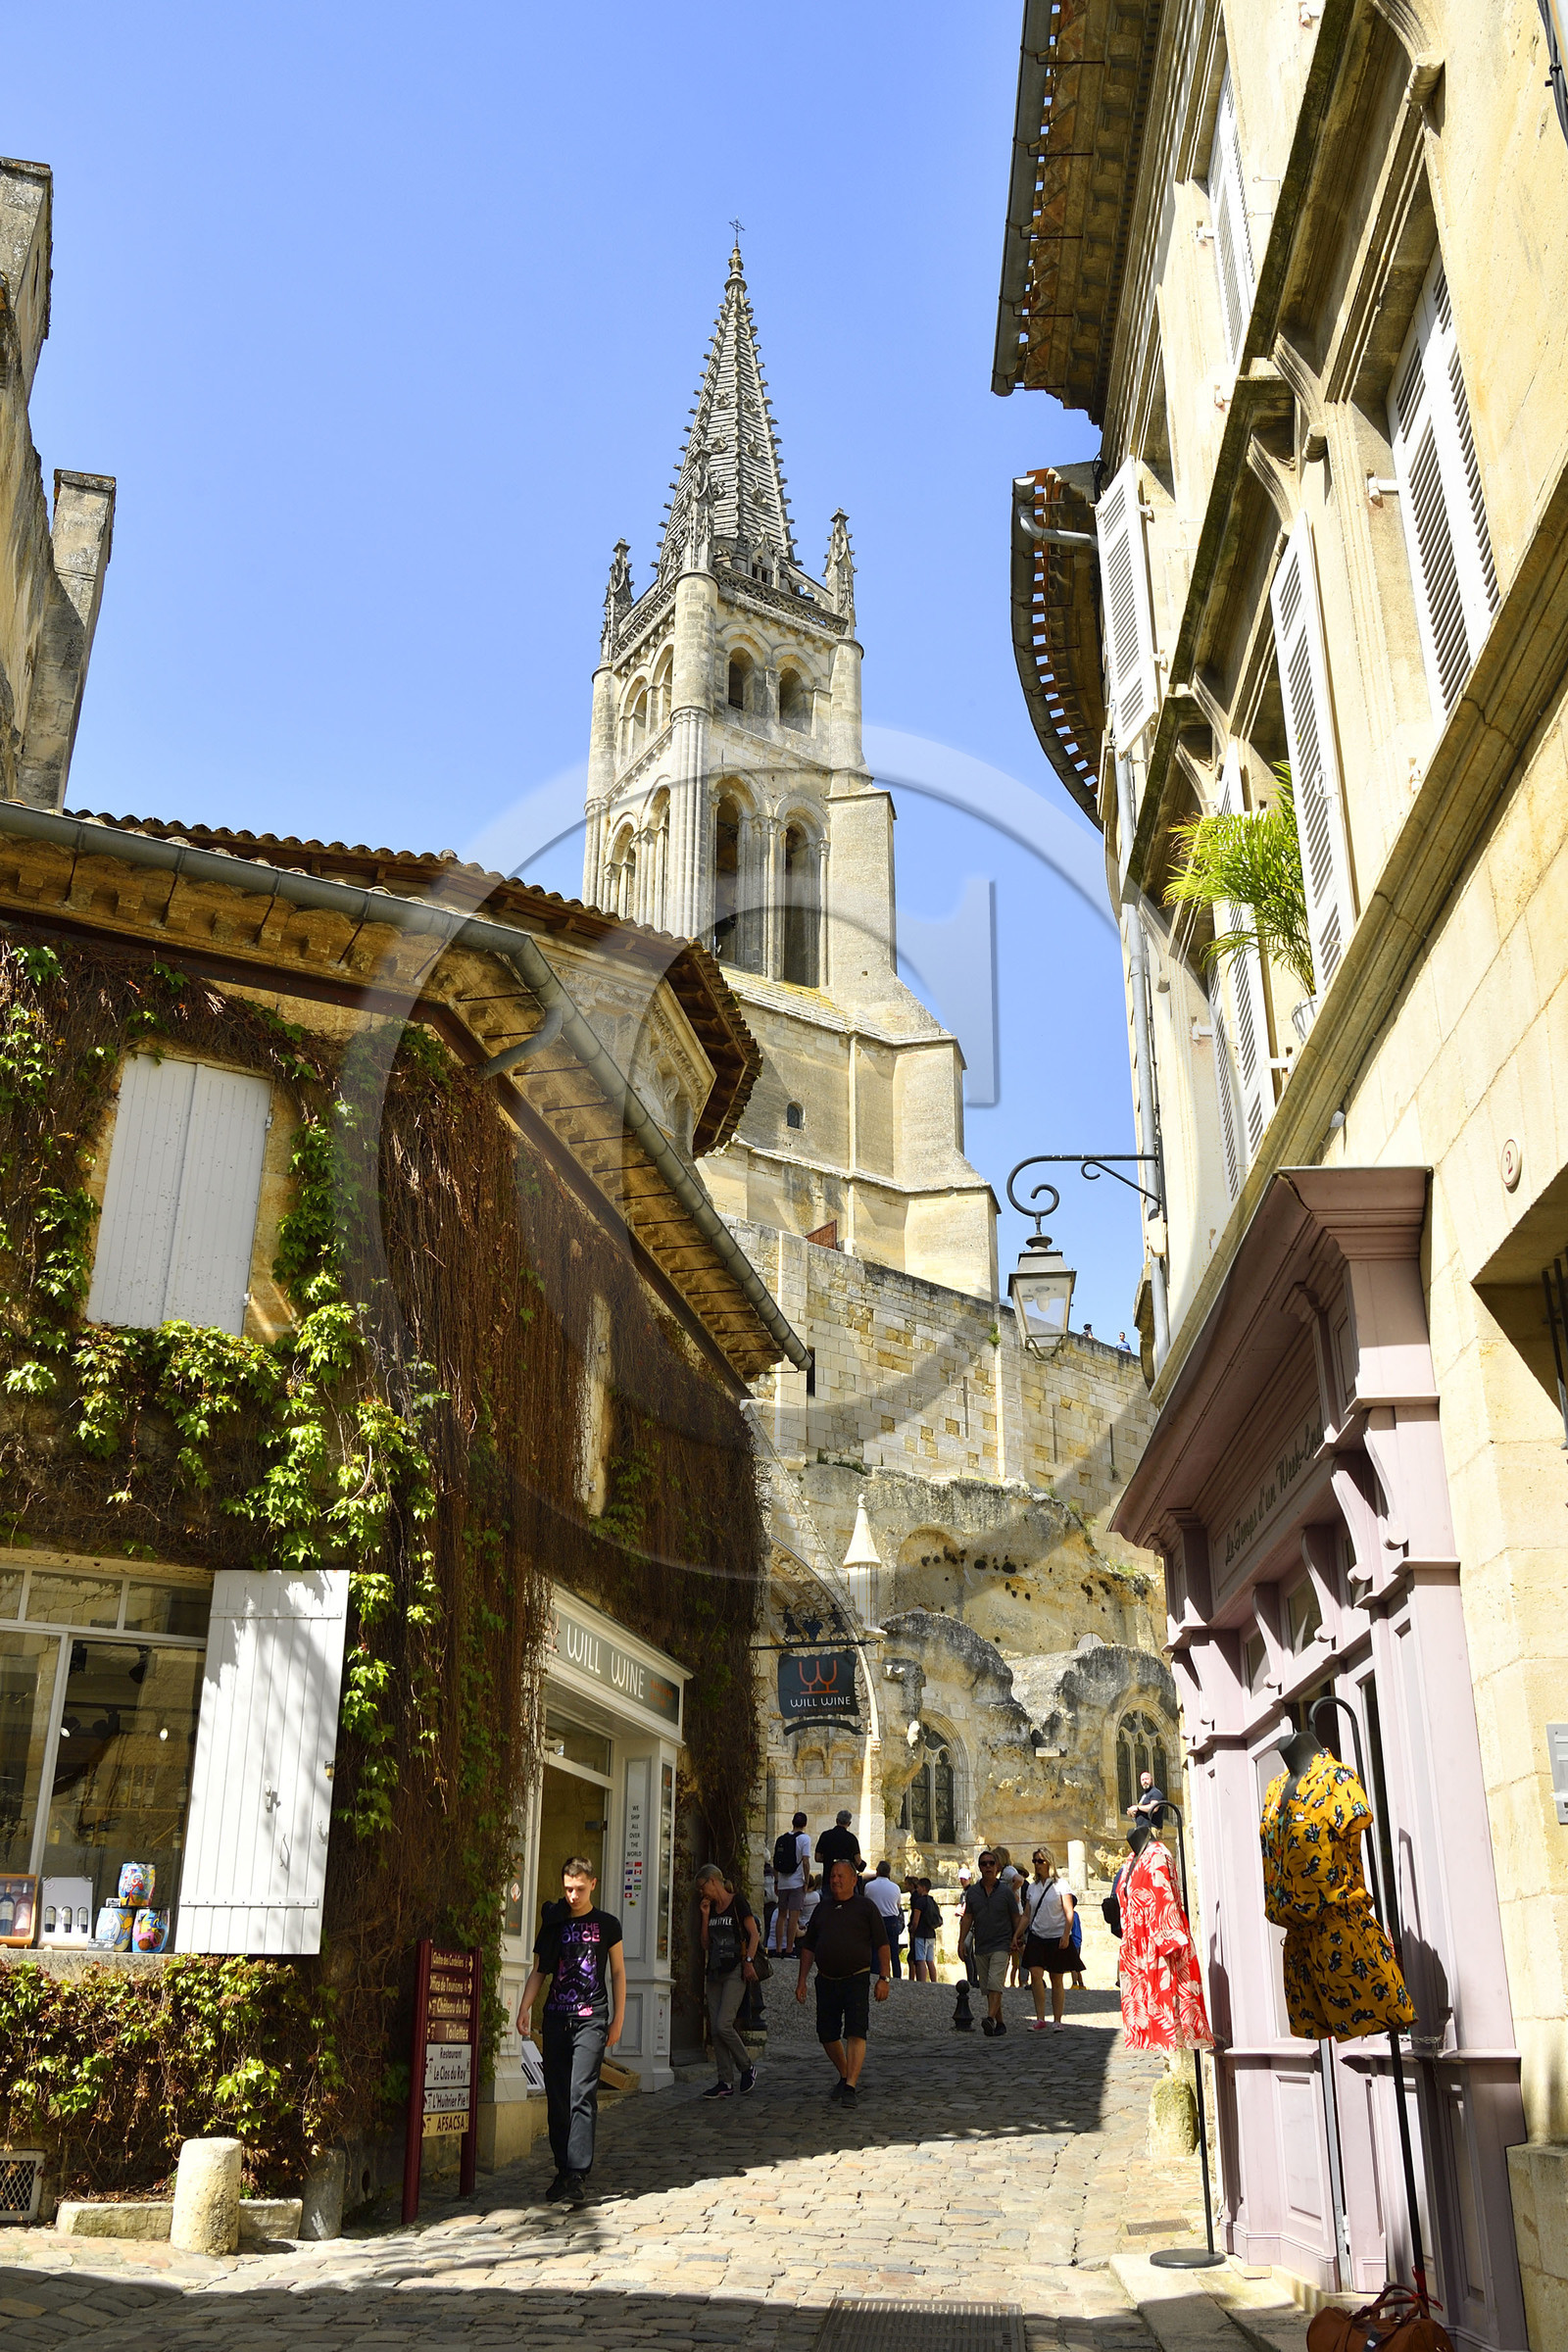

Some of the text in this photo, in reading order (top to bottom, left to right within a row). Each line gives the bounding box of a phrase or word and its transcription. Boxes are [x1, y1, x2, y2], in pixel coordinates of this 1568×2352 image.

[1505, 1151, 1513, 1175] 2
[566, 1624, 601, 1675] WILL
[611, 1651, 645, 1699] WINE
[790, 1696, 851, 1707] WILL WINE
[579, 1923, 601, 1932] THE
[562, 1931, 601, 1943] ORCE
[441, 1977, 446, 1991] de
[446, 1977, 464, 1992] Tourisme
[456, 1998, 462, 2013] du
[462, 1999, 470, 2019] Roy
[446, 2023, 468, 2039] Toilettes
[439, 2047, 463, 2059] Restaurant
[433, 2065, 466, 2083] Le Clos du Roy
[457, 2093, 466, 2107] Pie
[436, 2115, 465, 2132] AFSACSA
